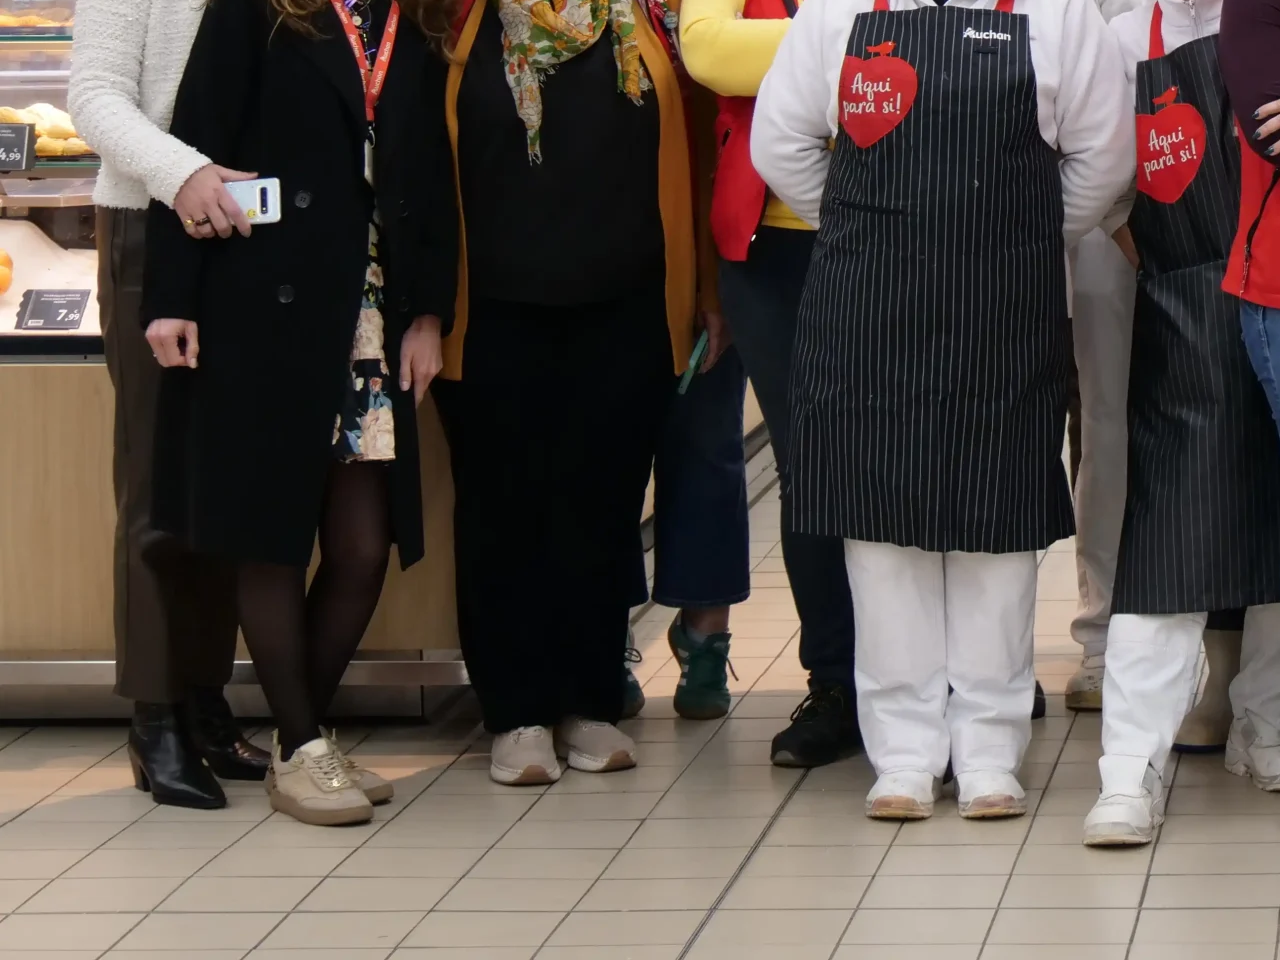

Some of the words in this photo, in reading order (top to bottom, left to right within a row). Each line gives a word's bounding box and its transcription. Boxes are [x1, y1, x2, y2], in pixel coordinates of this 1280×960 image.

[963, 26, 1012, 41] Auchan
[851, 72, 892, 101] Aqui
[843, 100, 876, 121] para
[882, 92, 901, 115] si!
[1148, 126, 1185, 154] Aqui
[1143, 153, 1175, 182] para
[1180, 138, 1197, 163] si!
